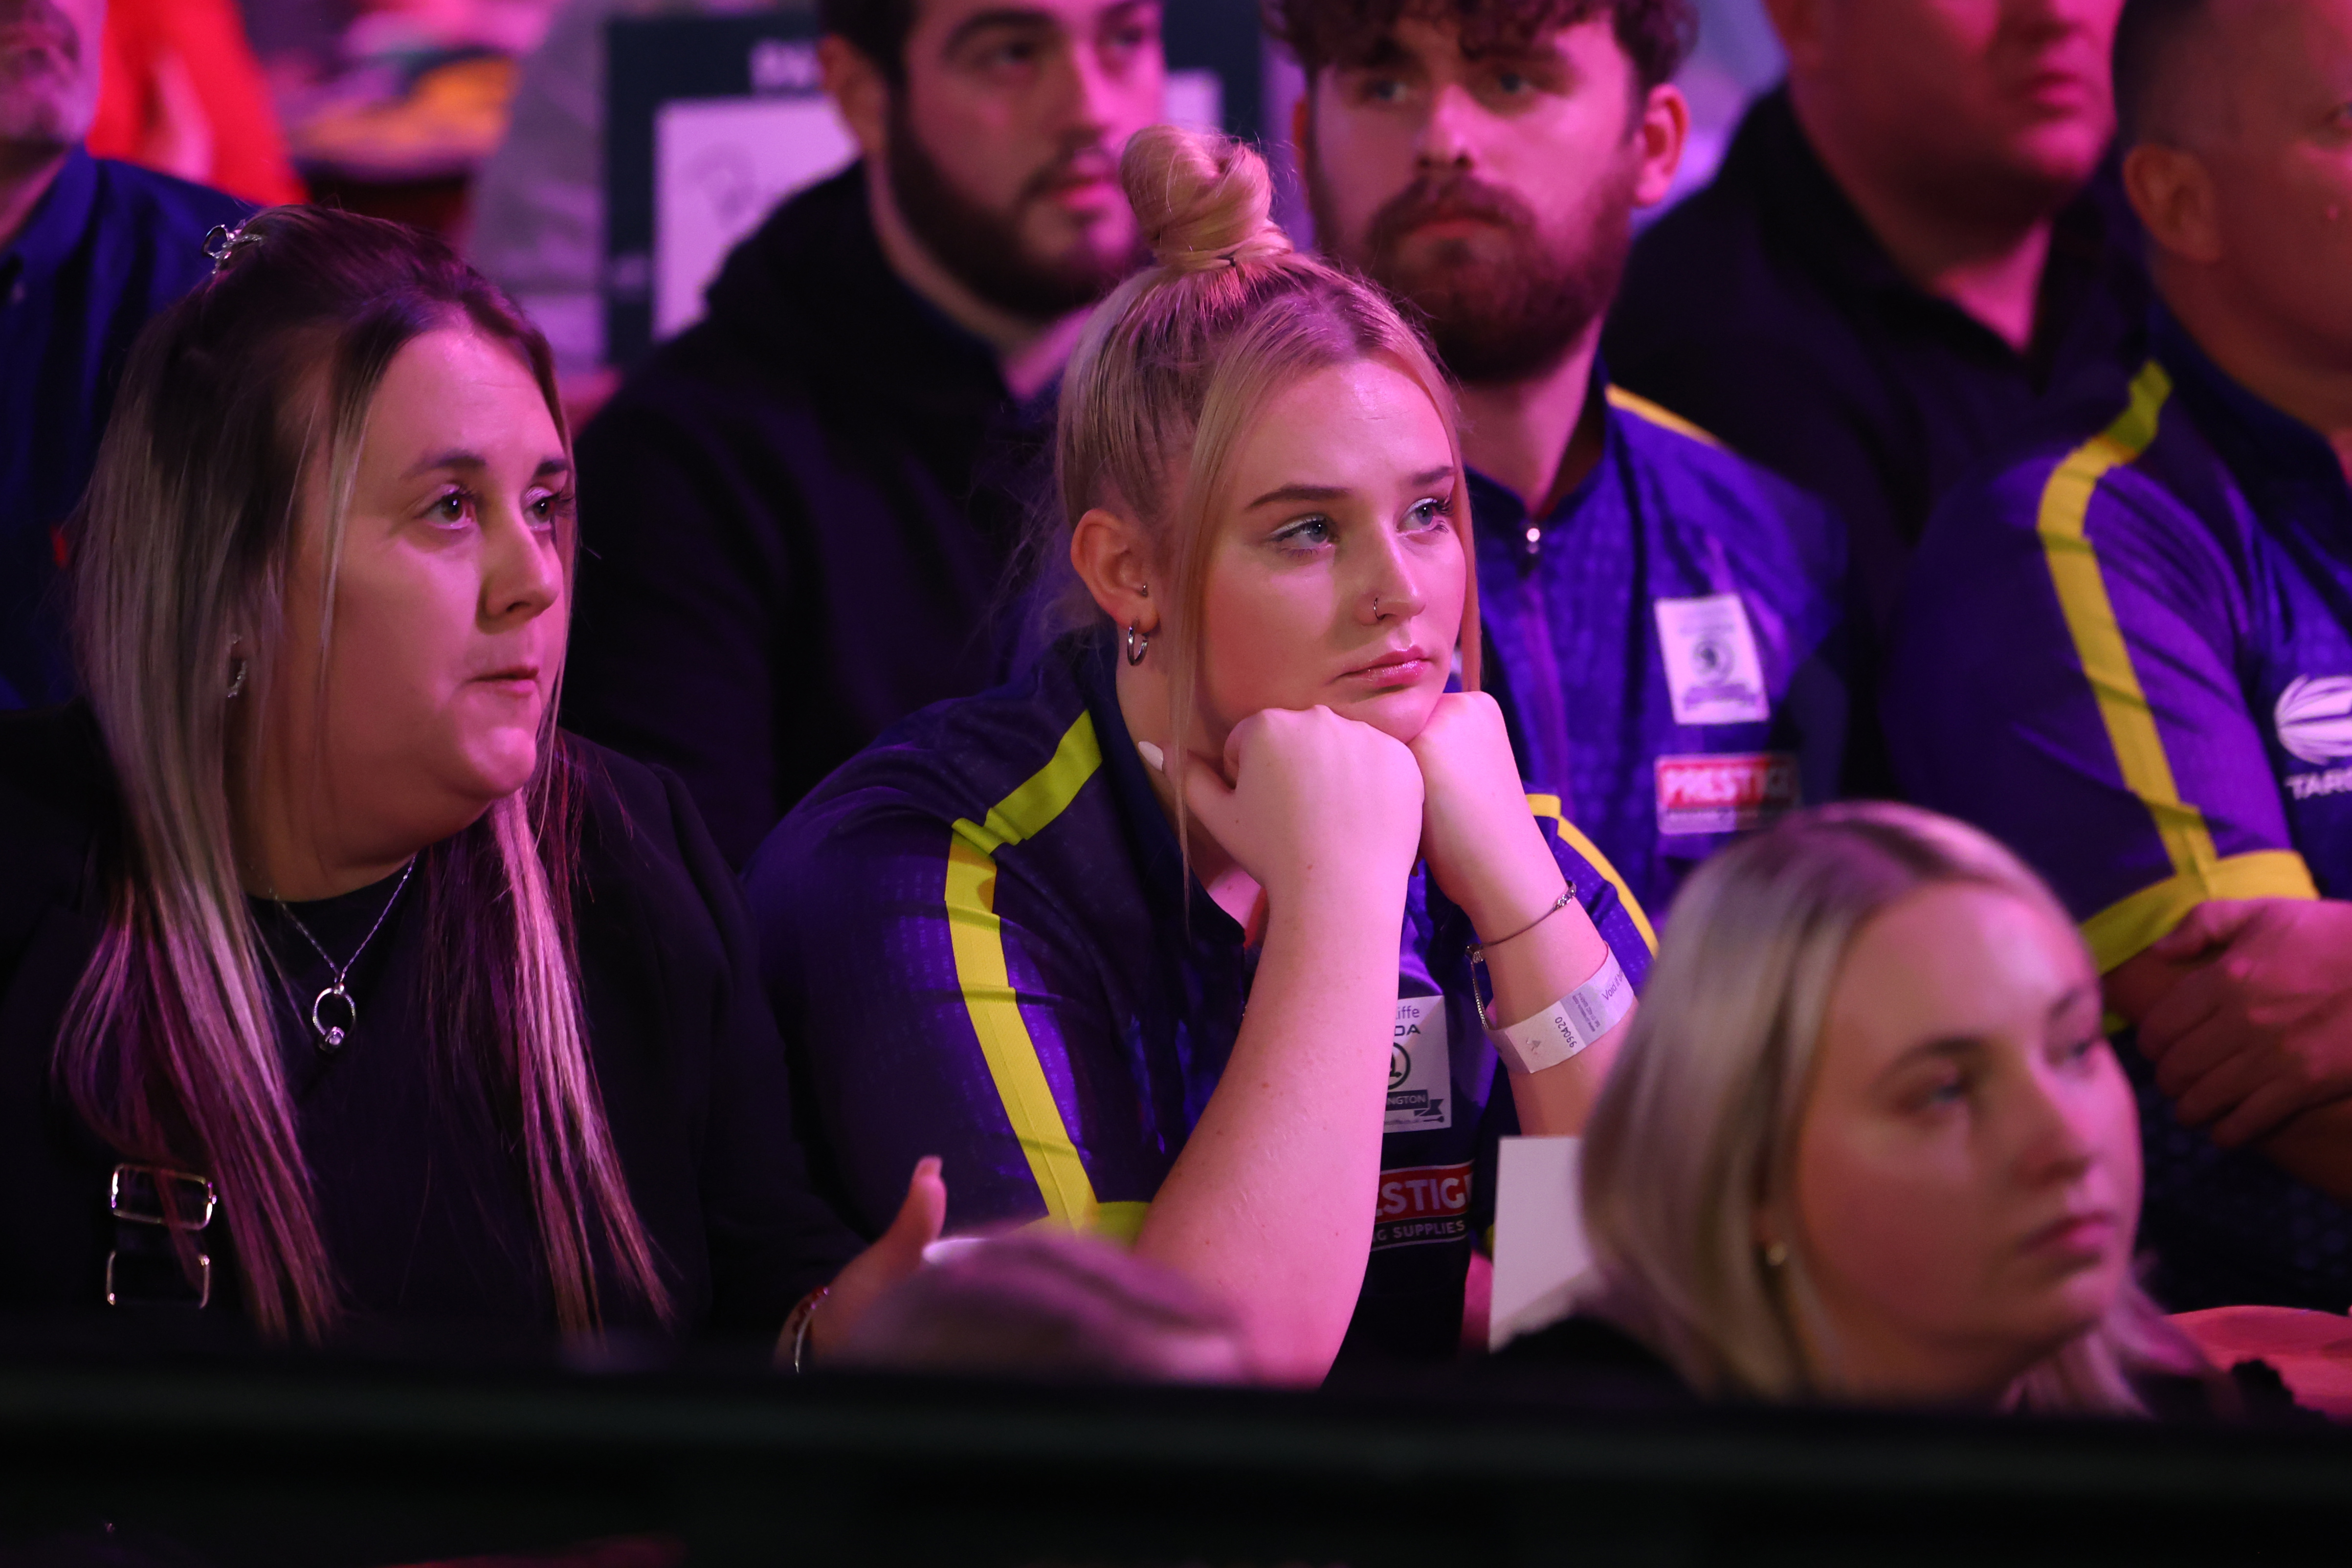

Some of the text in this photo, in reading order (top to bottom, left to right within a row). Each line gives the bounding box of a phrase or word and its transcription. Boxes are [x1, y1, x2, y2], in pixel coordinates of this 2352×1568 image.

[1396, 1005, 1420, 1020] iffe
[1555, 1016, 1577, 1048] 990420
[1393, 1220, 1465, 1238] SUPPLIES
